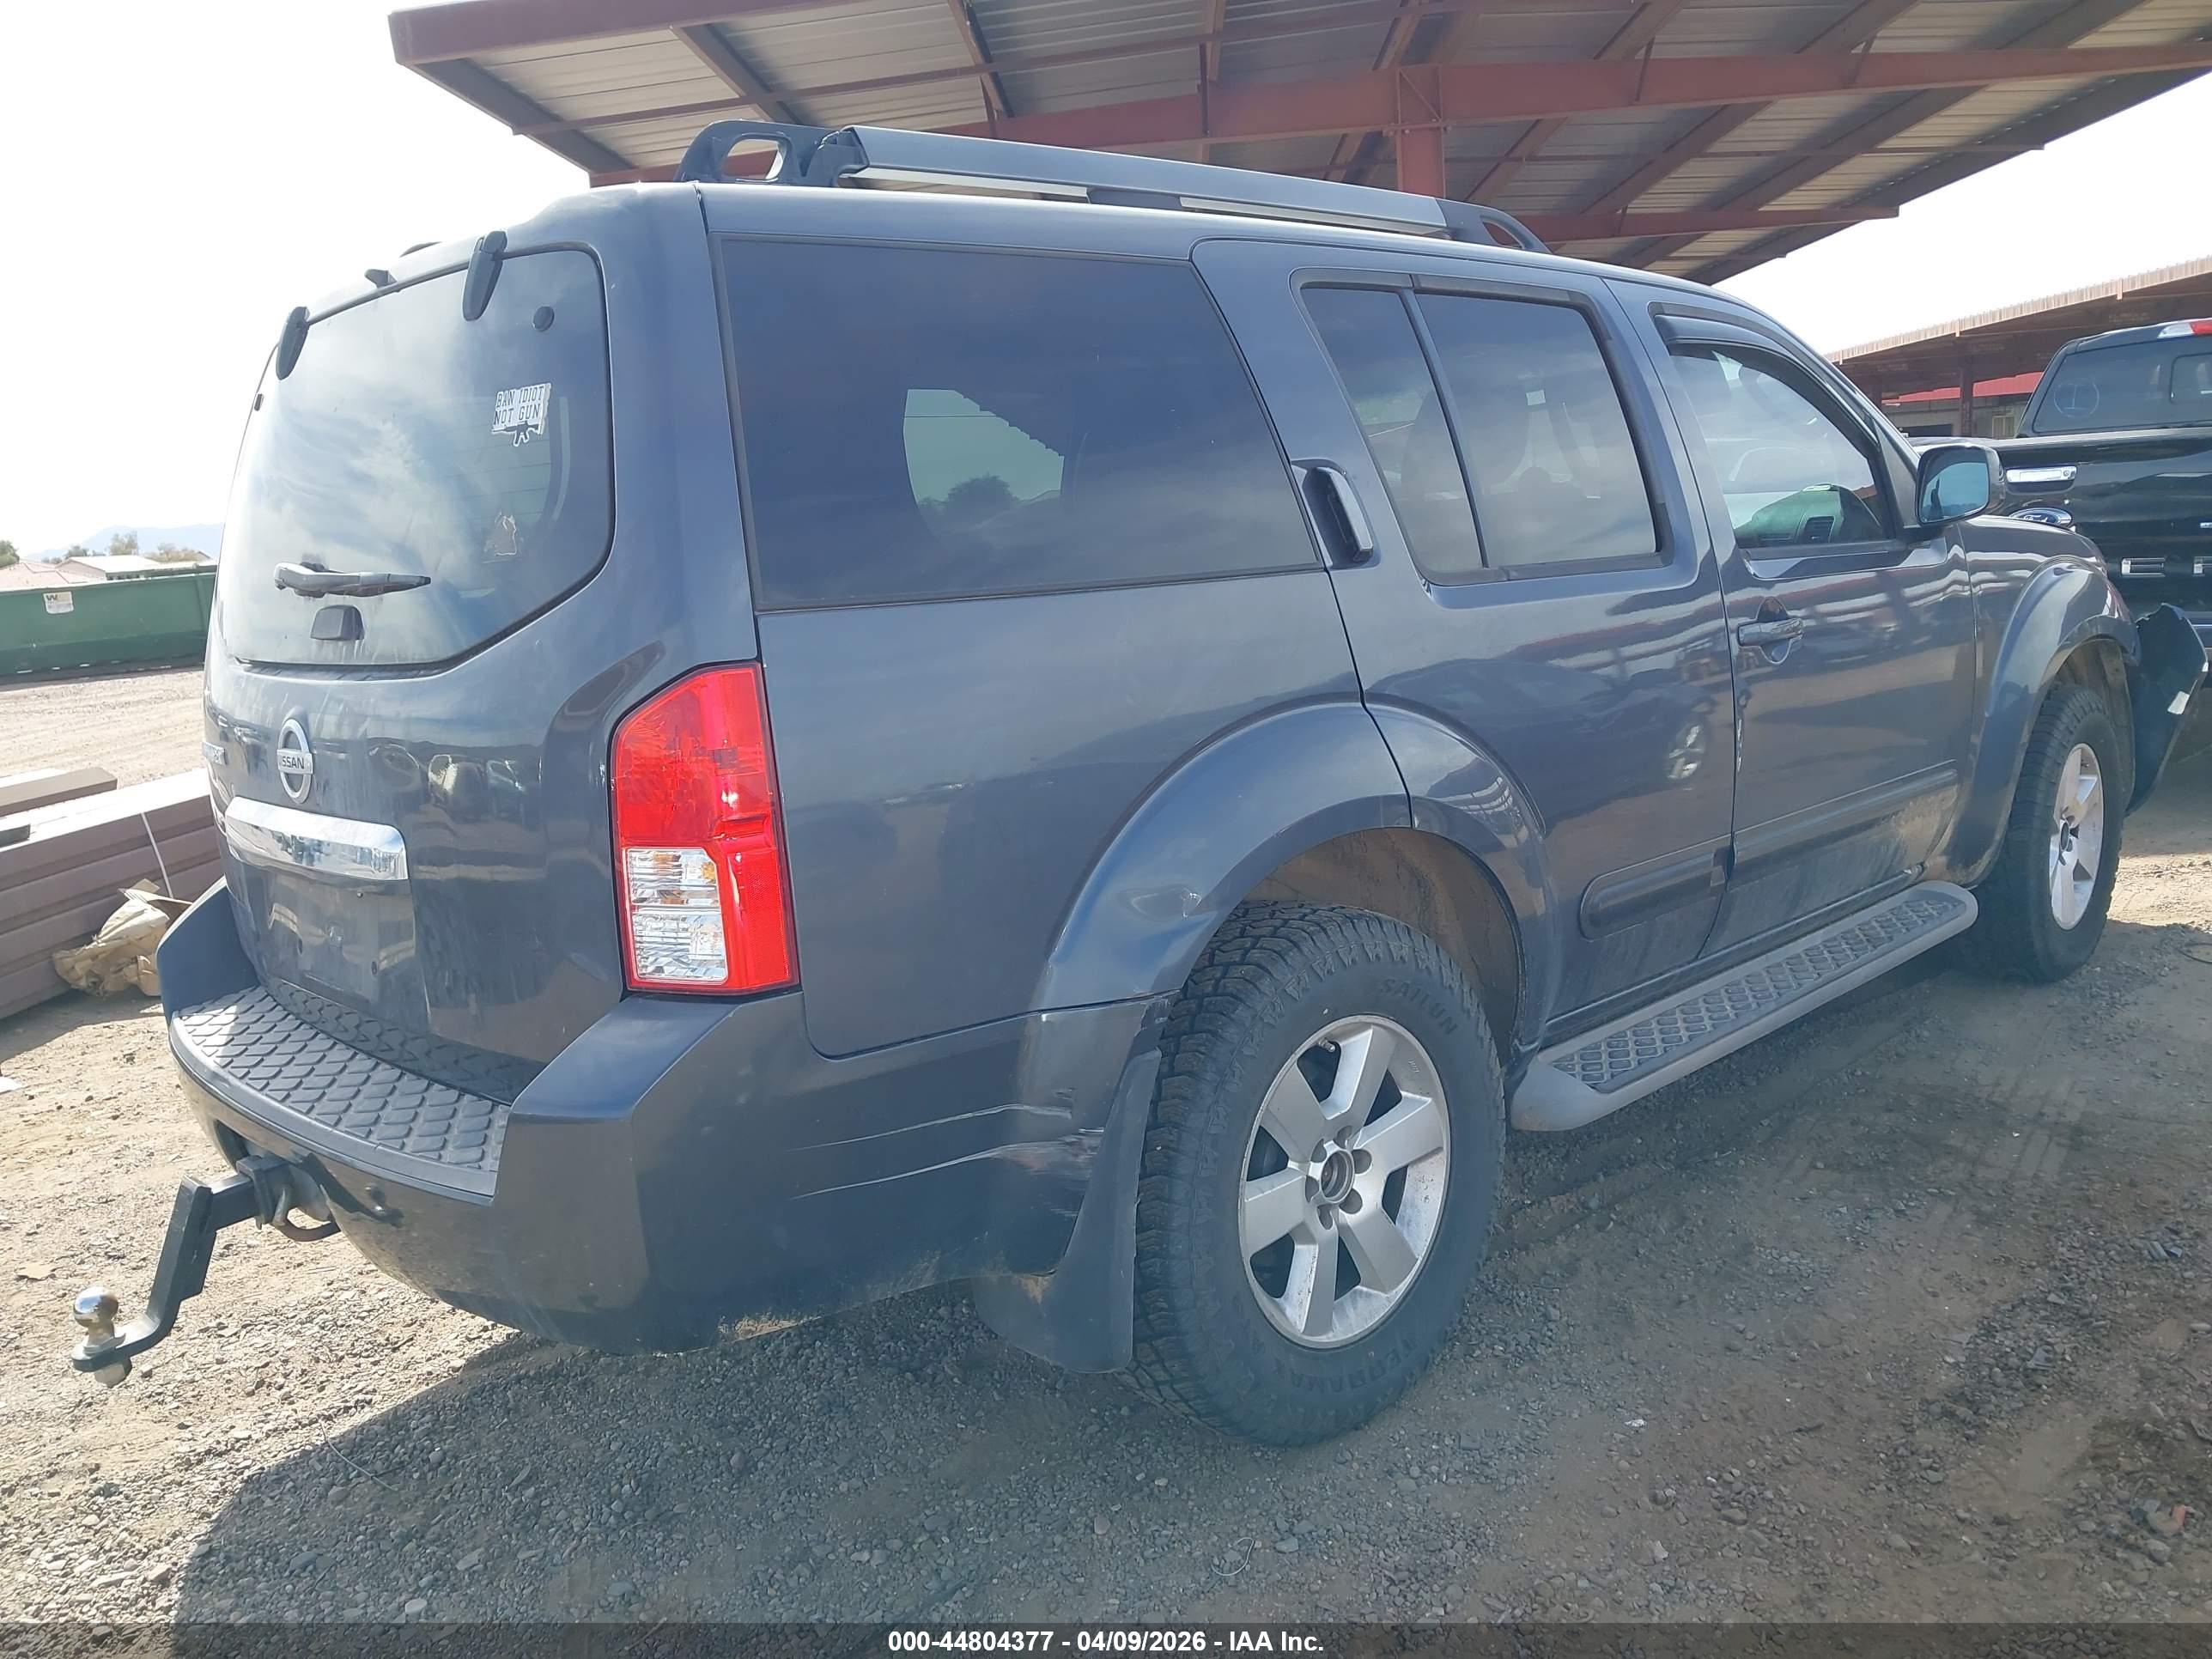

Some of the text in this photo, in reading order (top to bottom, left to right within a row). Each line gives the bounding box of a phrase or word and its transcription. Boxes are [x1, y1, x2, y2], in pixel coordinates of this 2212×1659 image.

[496, 386, 544, 408] BAN IDIOT
[494, 403, 541, 425] NOT GUN
